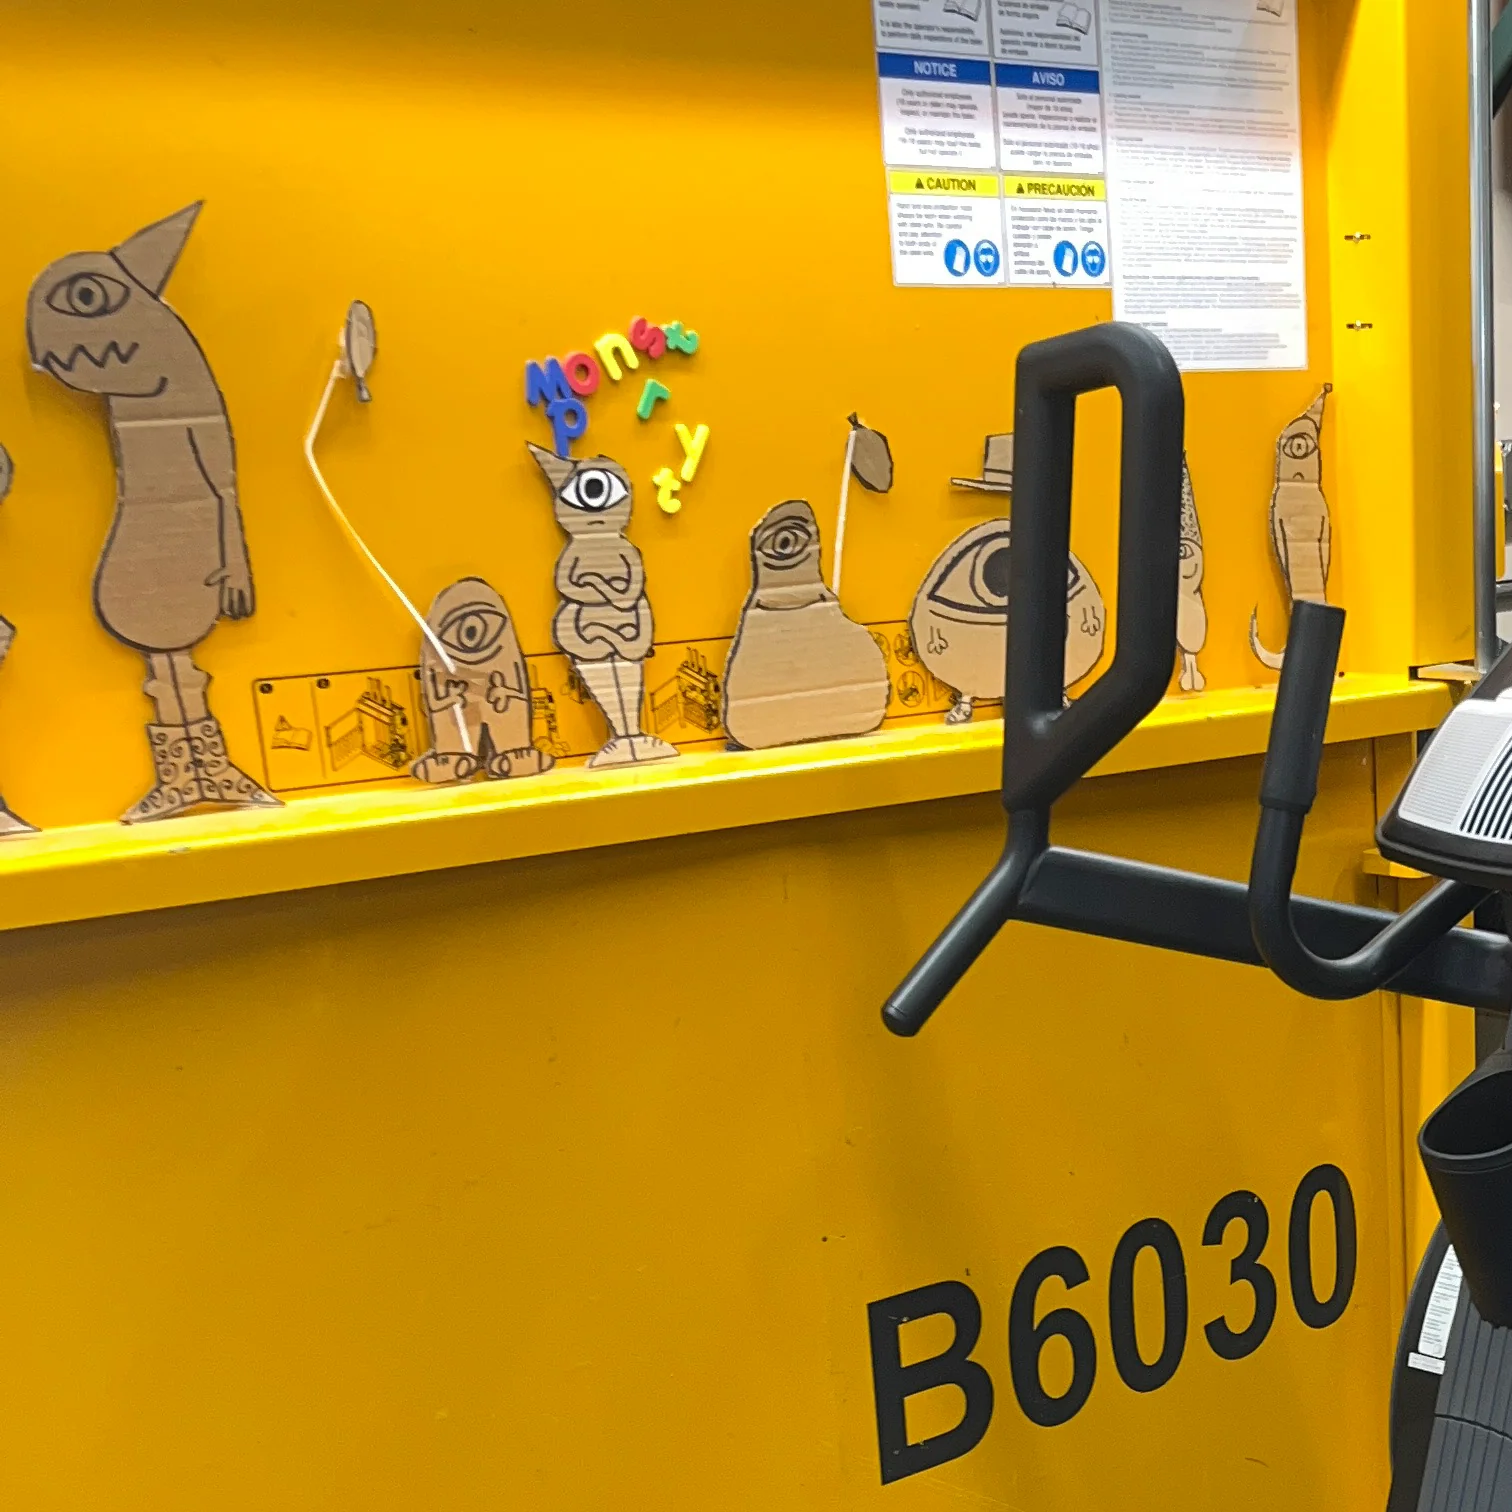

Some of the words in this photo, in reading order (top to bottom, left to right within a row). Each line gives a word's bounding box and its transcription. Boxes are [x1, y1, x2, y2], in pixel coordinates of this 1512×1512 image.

[914, 61, 957, 78] NOTICE
[1032, 72, 1065, 86] AVISO
[926, 178, 976, 191] CAUTION
[866, 1163, 1357, 1486] B6030
